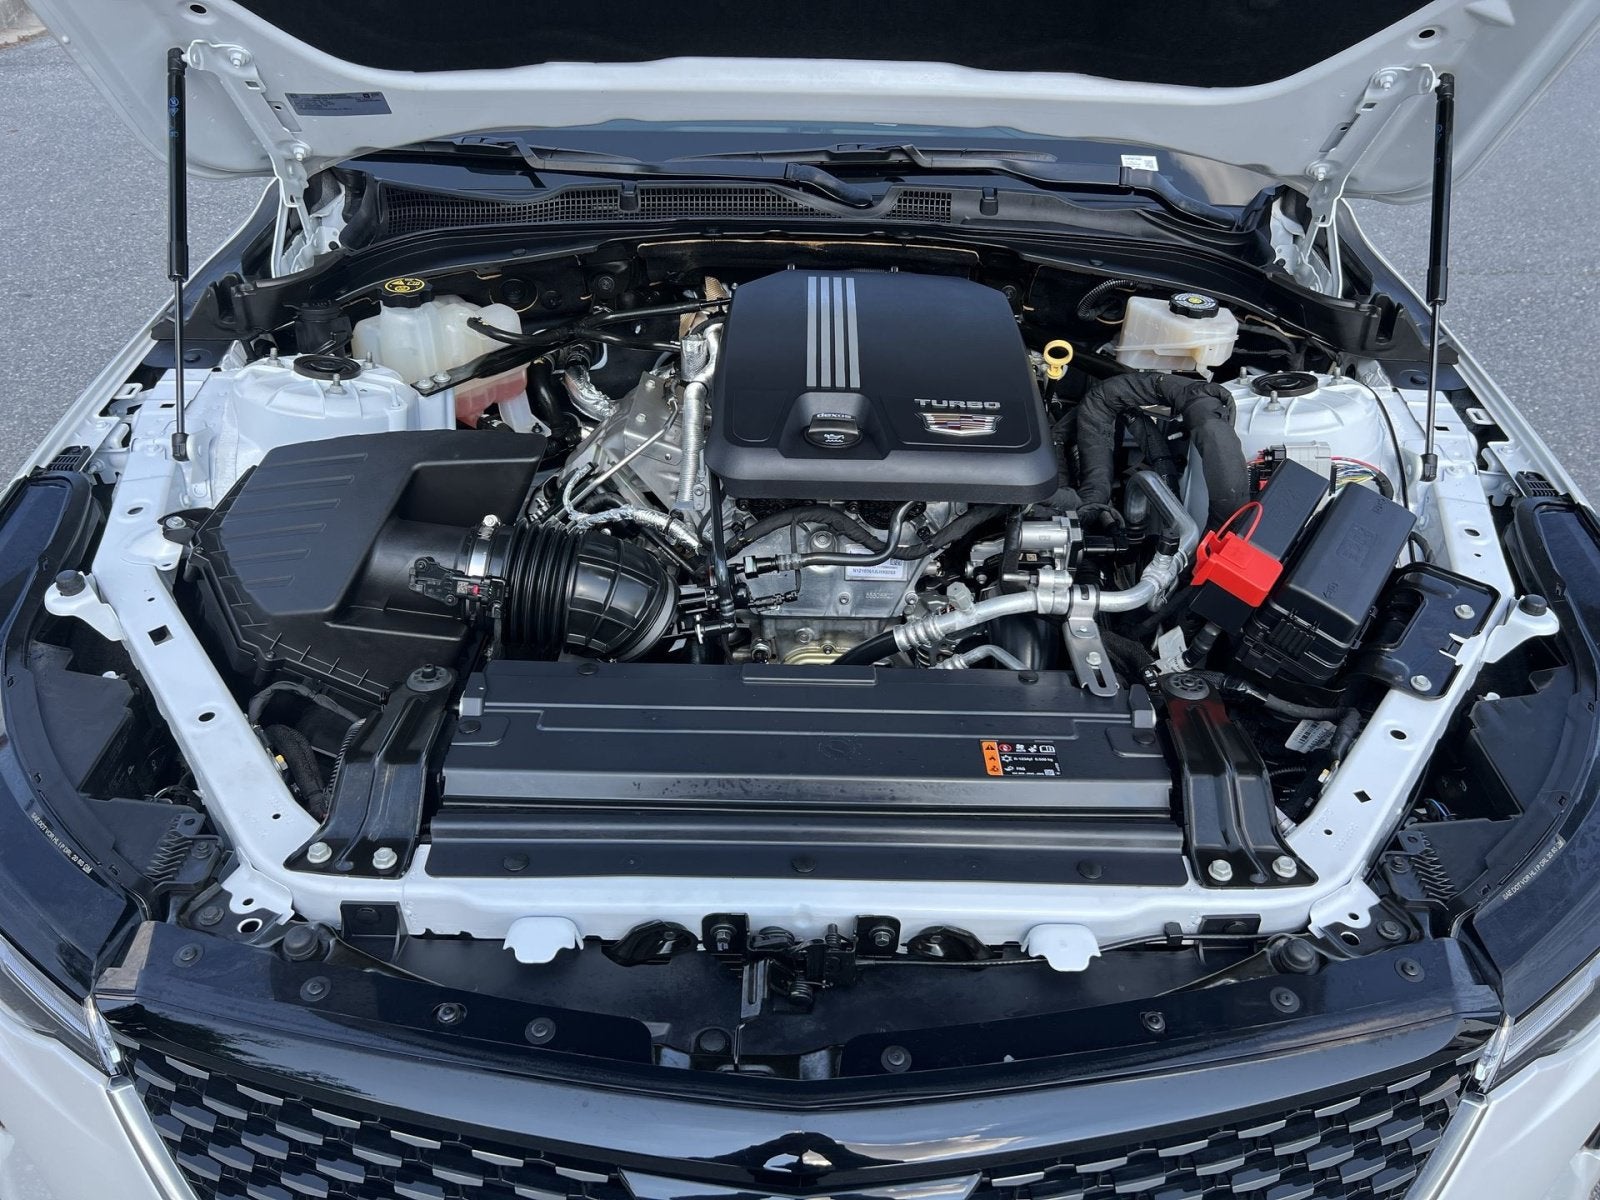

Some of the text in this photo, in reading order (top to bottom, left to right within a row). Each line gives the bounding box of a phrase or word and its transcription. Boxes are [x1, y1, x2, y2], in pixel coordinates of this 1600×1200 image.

[914, 398, 1001, 409] TURBO
[37, 820, 47, 831] DOT
[45, 828, 55, 840] VOR
[1502, 889, 1514, 900] SAE
[1511, 882, 1522, 894] DOT
[1519, 874, 1531, 885] VOR
[1539, 857, 1550, 867] DRL
